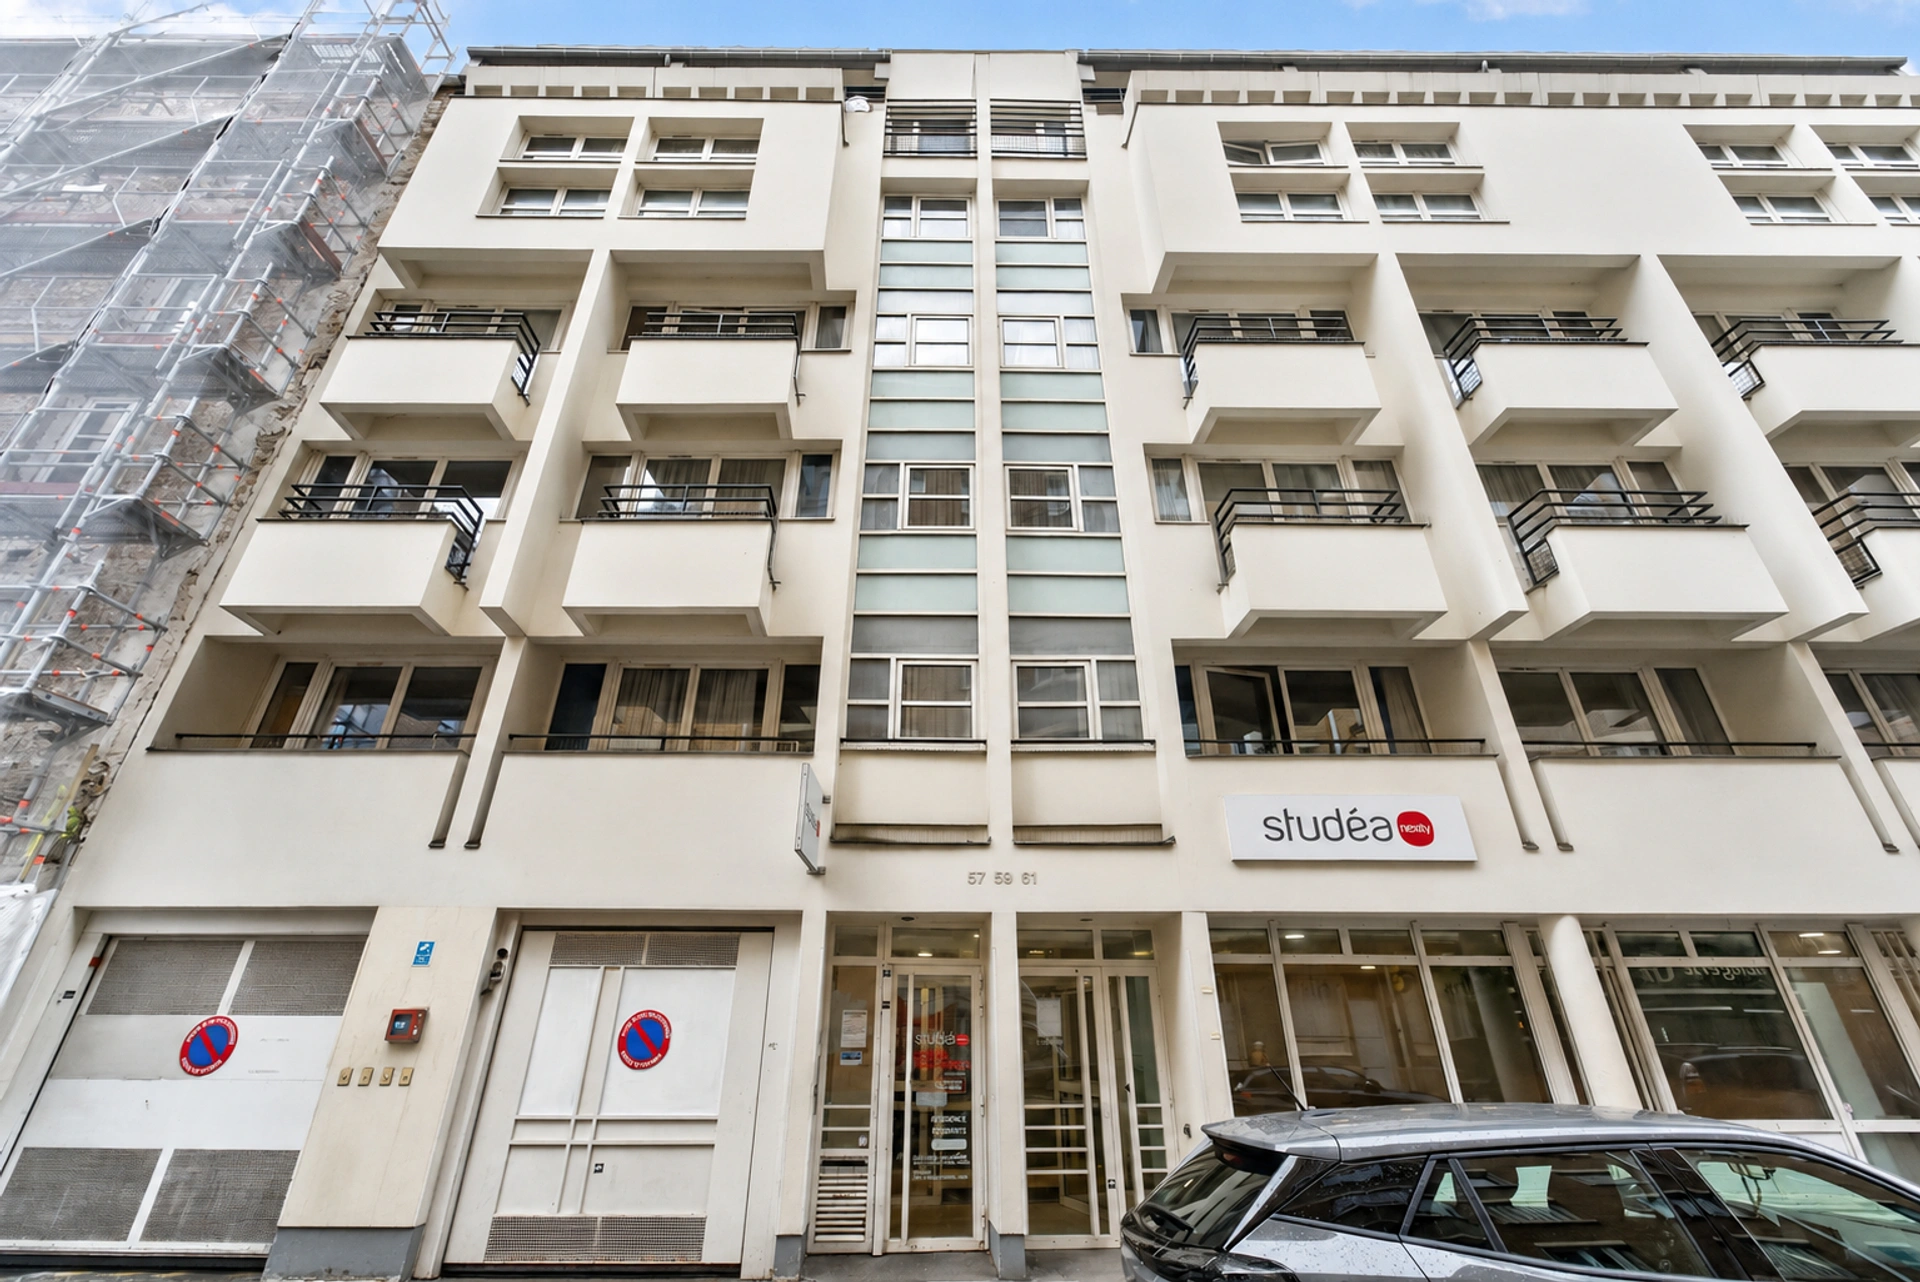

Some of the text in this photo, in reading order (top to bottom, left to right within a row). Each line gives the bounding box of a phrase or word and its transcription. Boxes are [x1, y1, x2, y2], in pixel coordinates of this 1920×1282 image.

[1263, 807, 1394, 842] studéa
[967, 871, 1037, 886] 57 59 61
